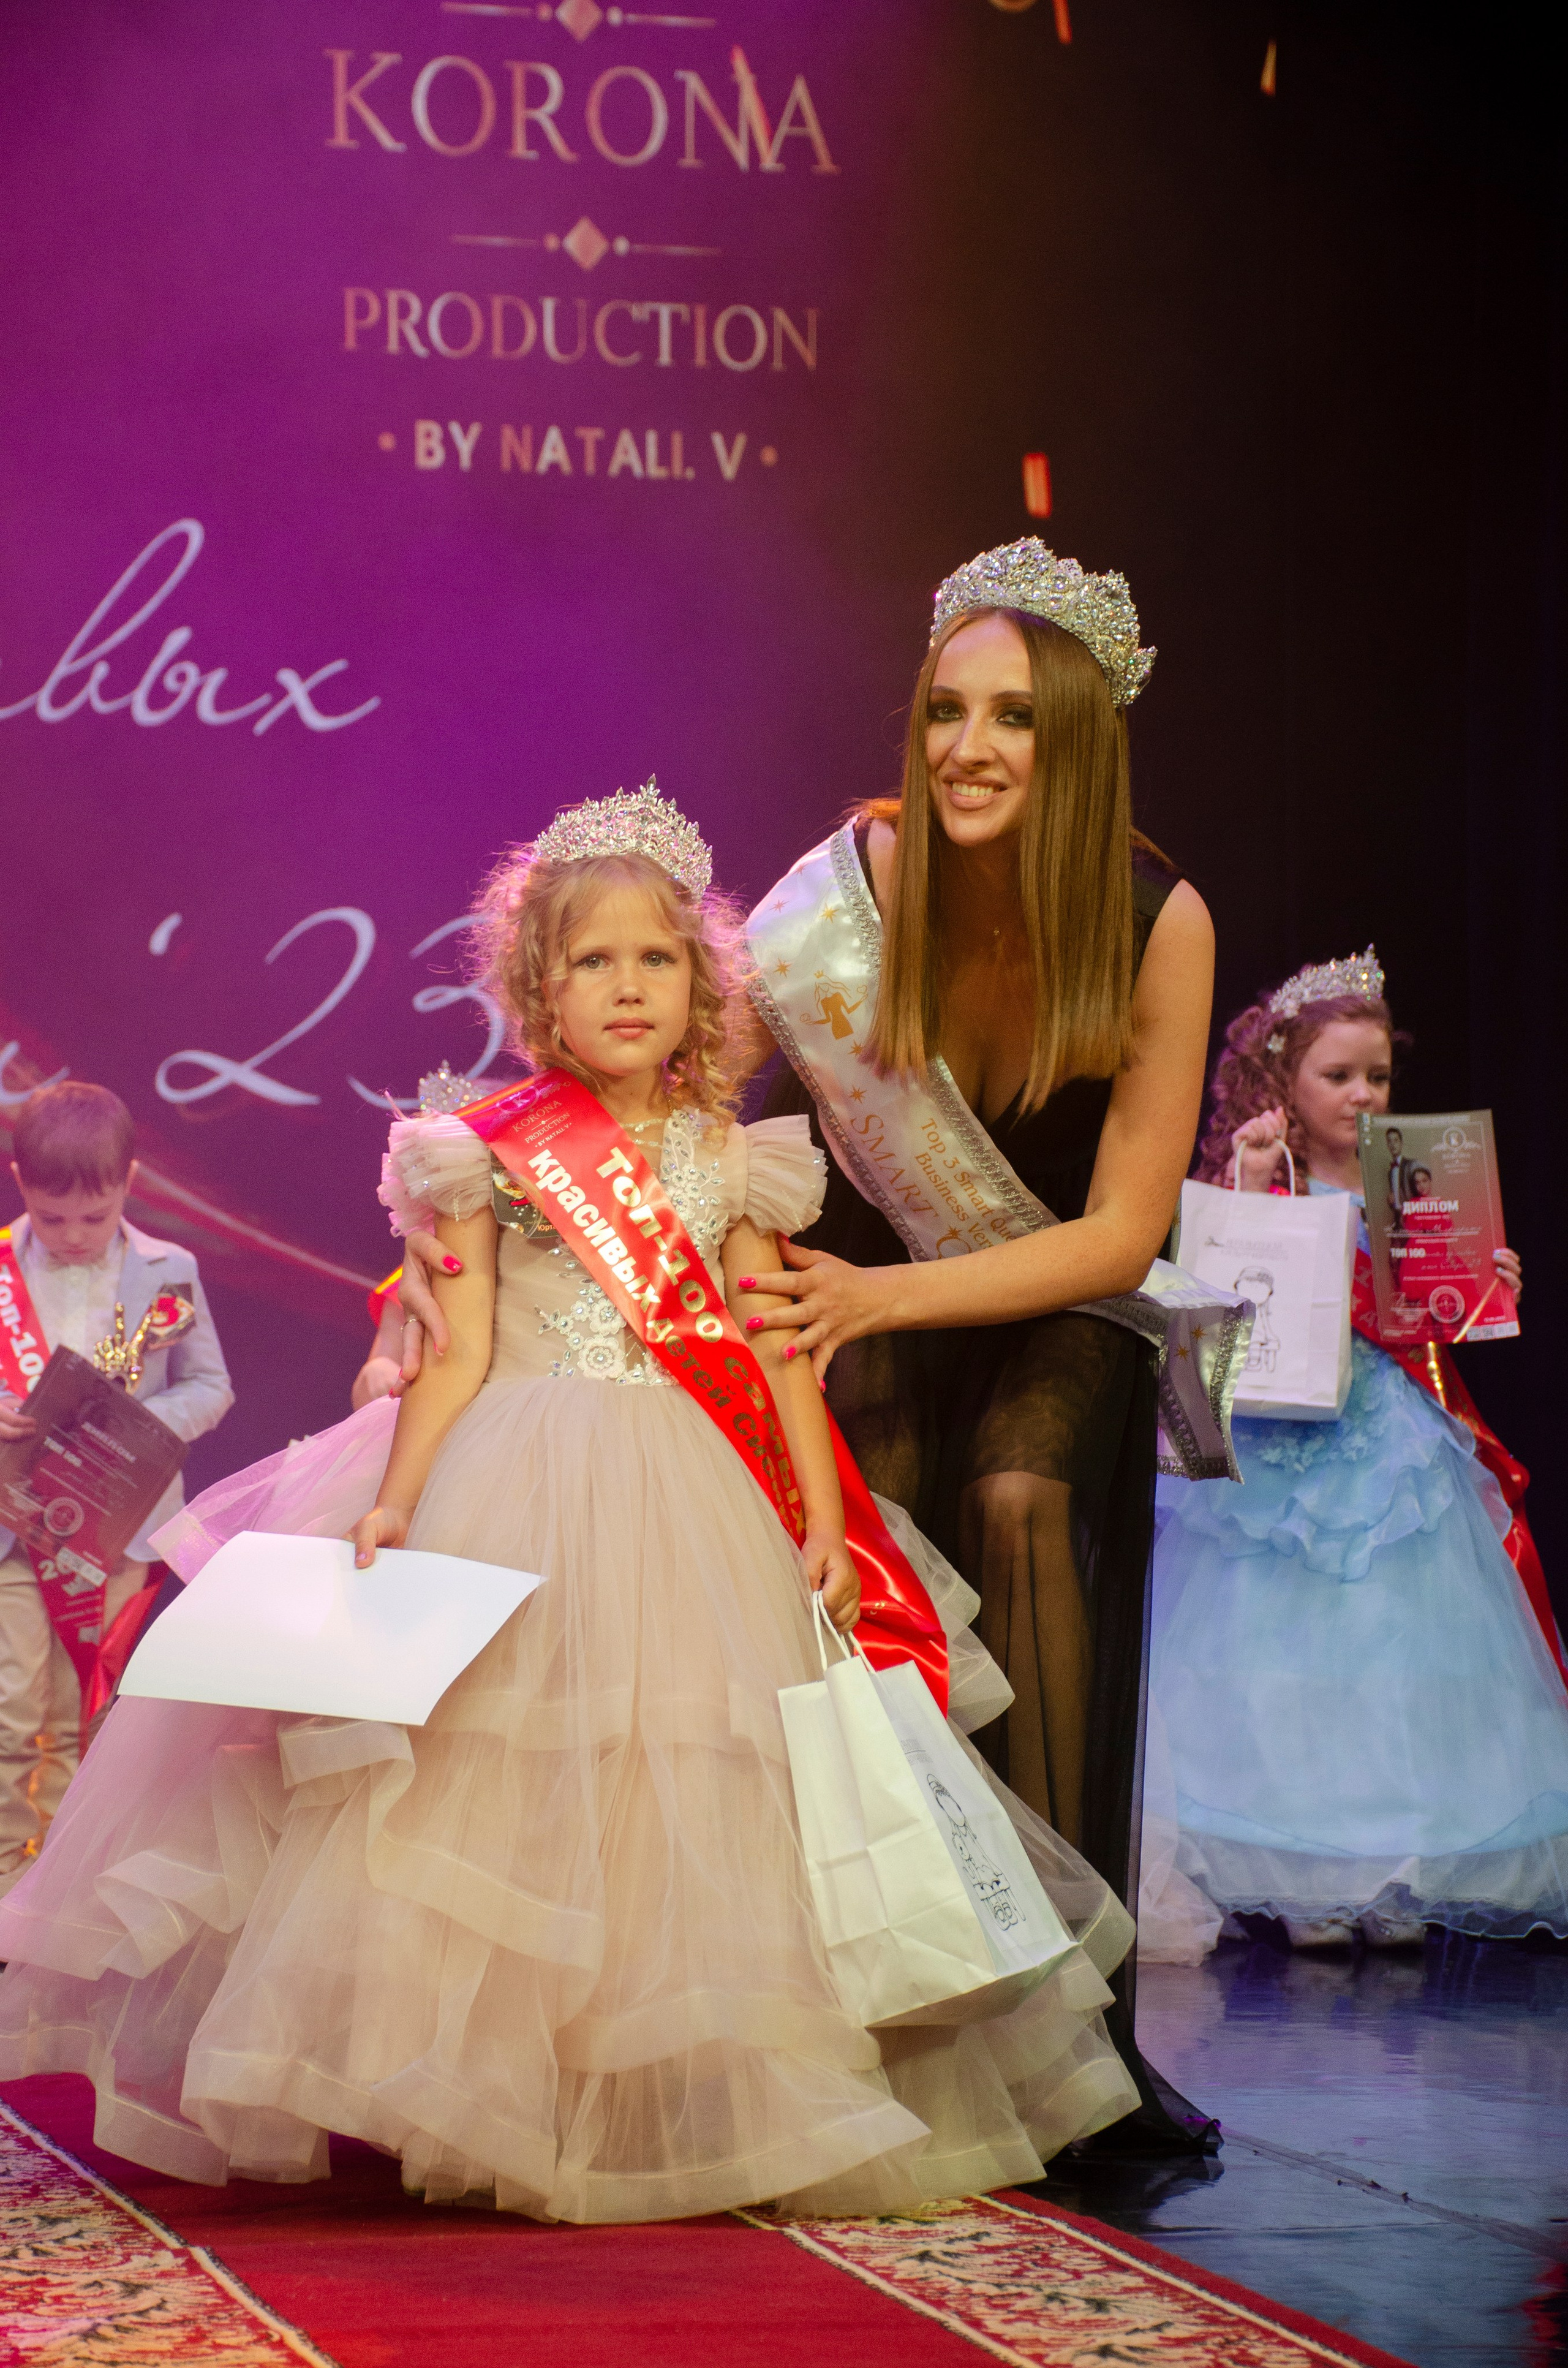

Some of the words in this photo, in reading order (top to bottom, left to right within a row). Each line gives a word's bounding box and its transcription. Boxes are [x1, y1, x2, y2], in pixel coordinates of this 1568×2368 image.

[323, 48, 842, 173] KORONA
[342, 287, 820, 372] PRODUCTION
[415, 419, 483, 472] BY
[710, 431, 748, 482] V
[512, 1100, 562, 1132] KORONA
[525, 1112, 570, 1144] PRODUCTION
[850, 1114, 939, 1218] SMART
[914, 1152, 970, 1222] Business
[921, 1118, 947, 1154] Top
[943, 1156, 960, 1169] 3
[954, 1171, 995, 1218] Smart
[1402, 1199, 1460, 1216] ДИПЛОМ
[528, 1149, 661, 1313] красивых
[646, 1317, 737, 1409] детей
[596, 1147, 724, 1344] Топ-100
